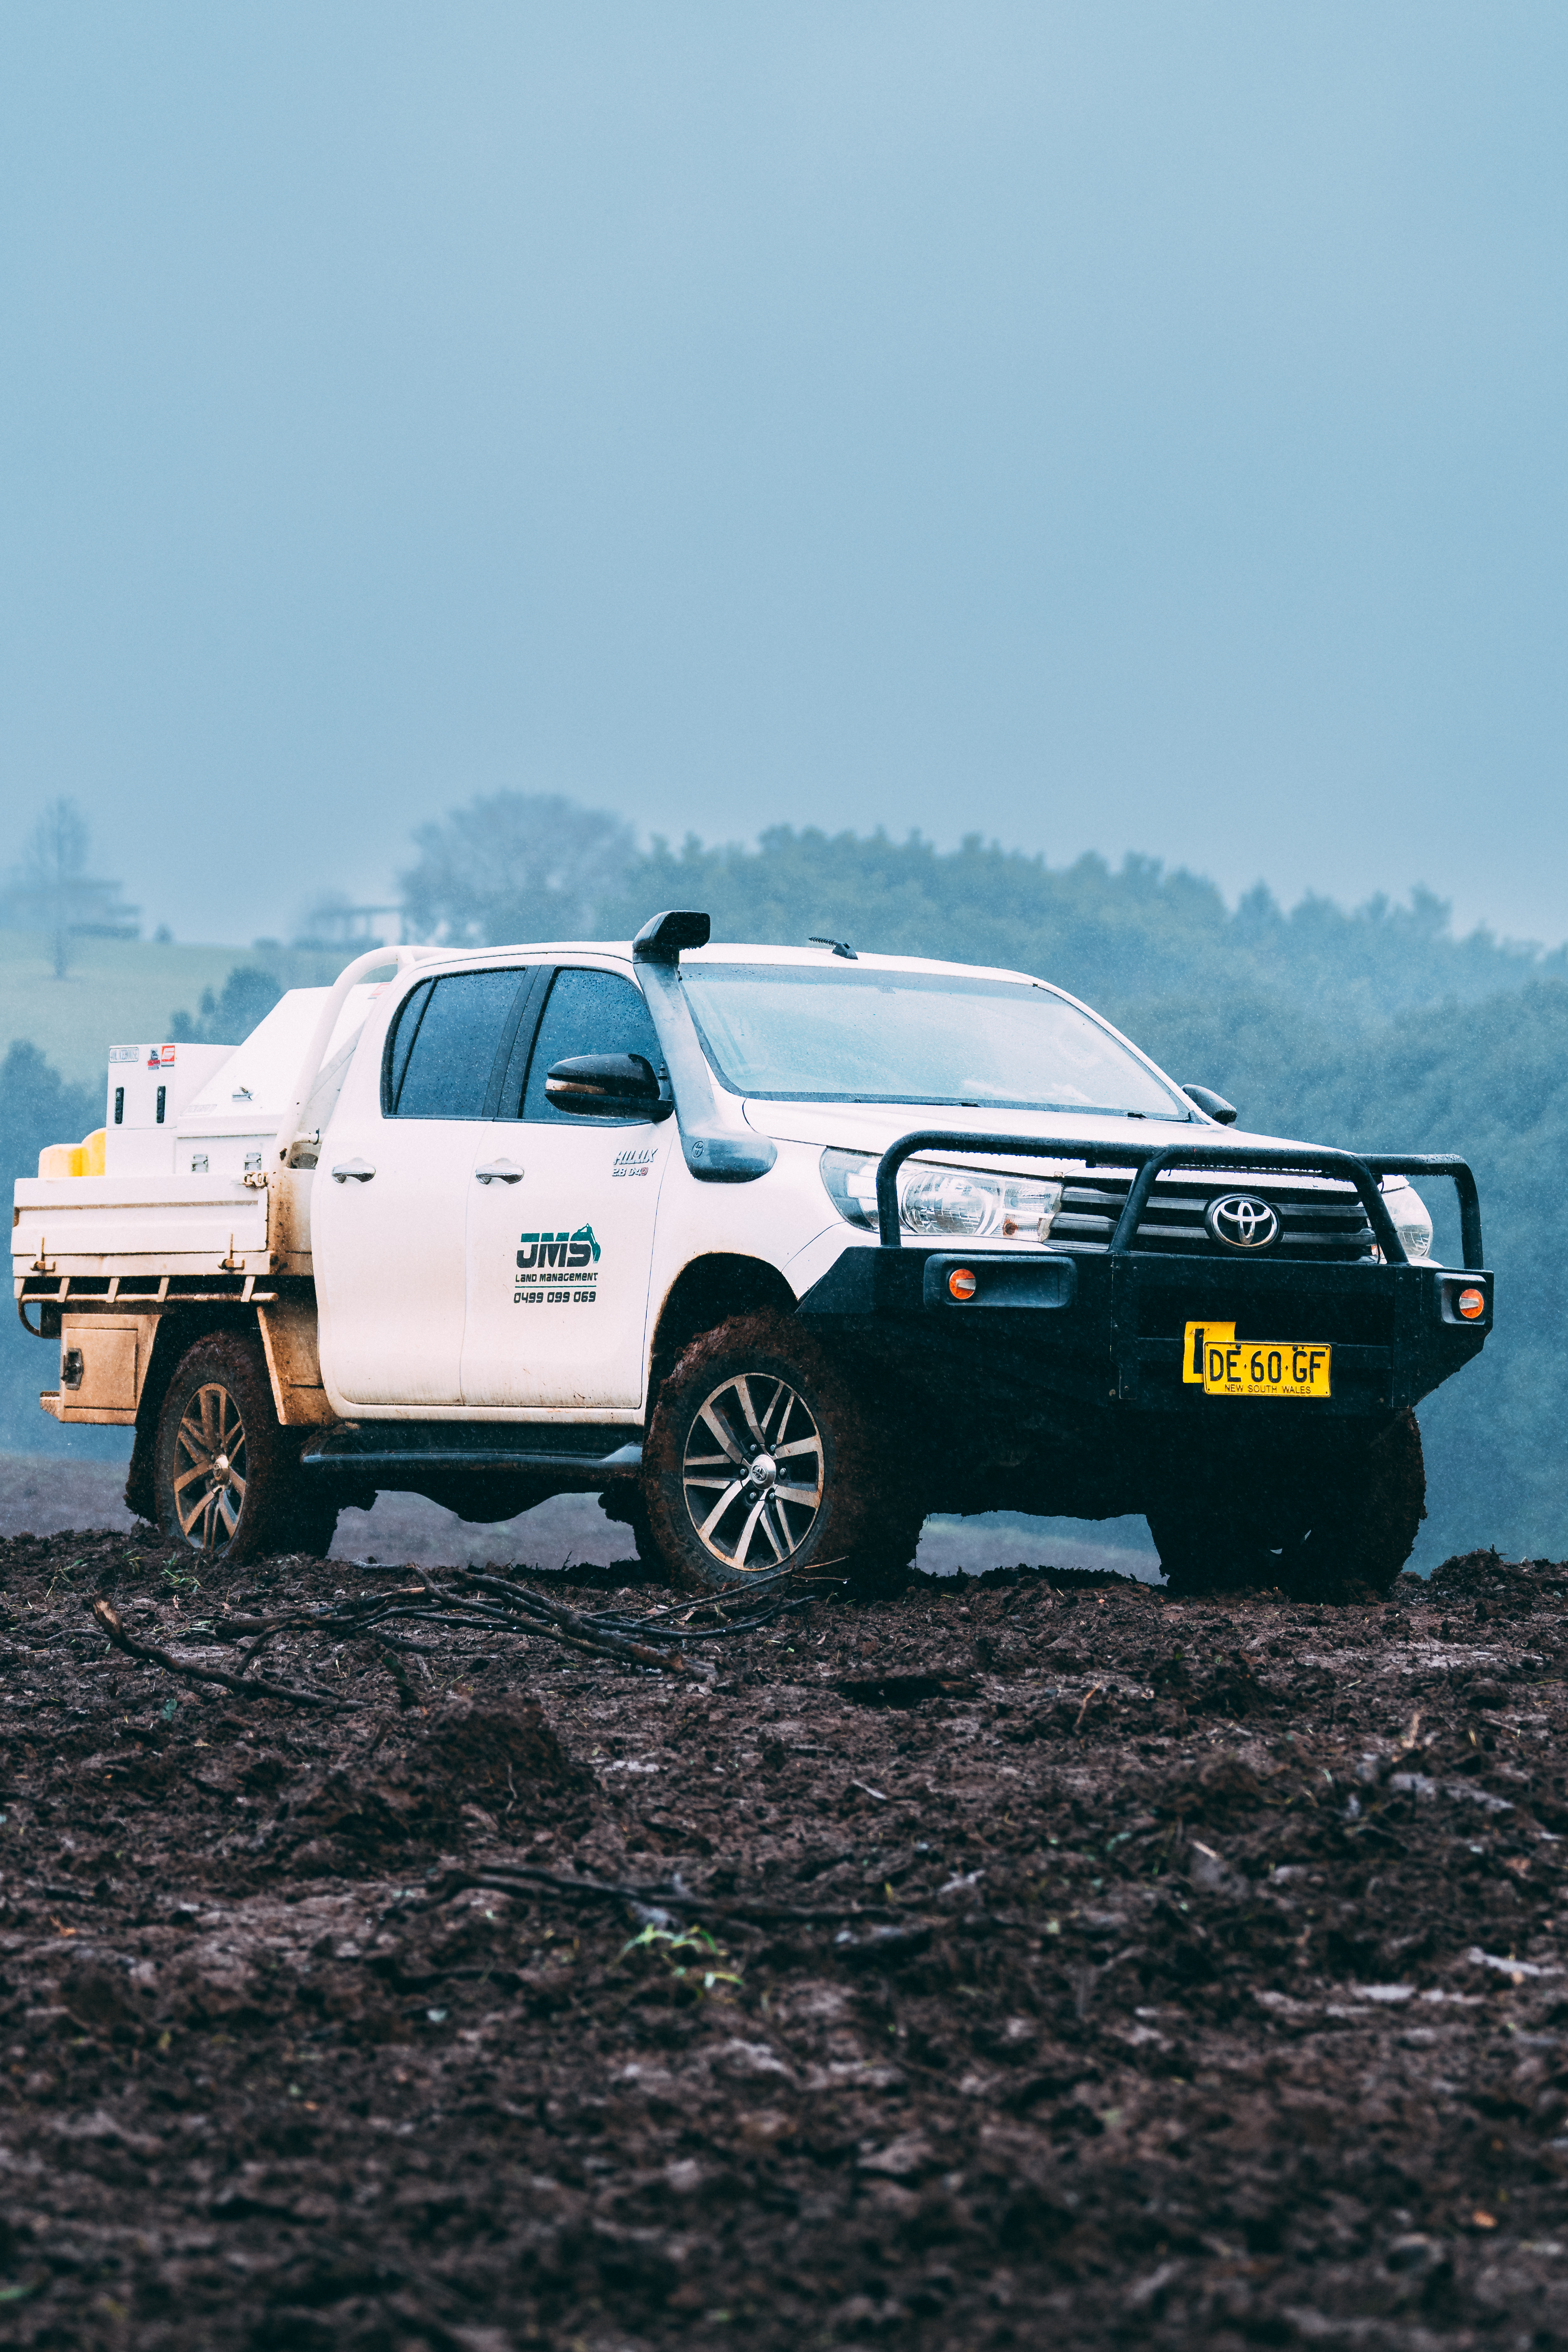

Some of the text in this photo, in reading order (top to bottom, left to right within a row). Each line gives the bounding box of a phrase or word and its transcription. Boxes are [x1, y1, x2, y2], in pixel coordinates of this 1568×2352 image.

[119, 1049, 137, 1060] ICEHOUSE
[516, 1232, 592, 1268] JMS
[513, 1291, 596, 1303] 0499 099 069
[1224, 1383, 1311, 1394] NEW SOUTH WALES
